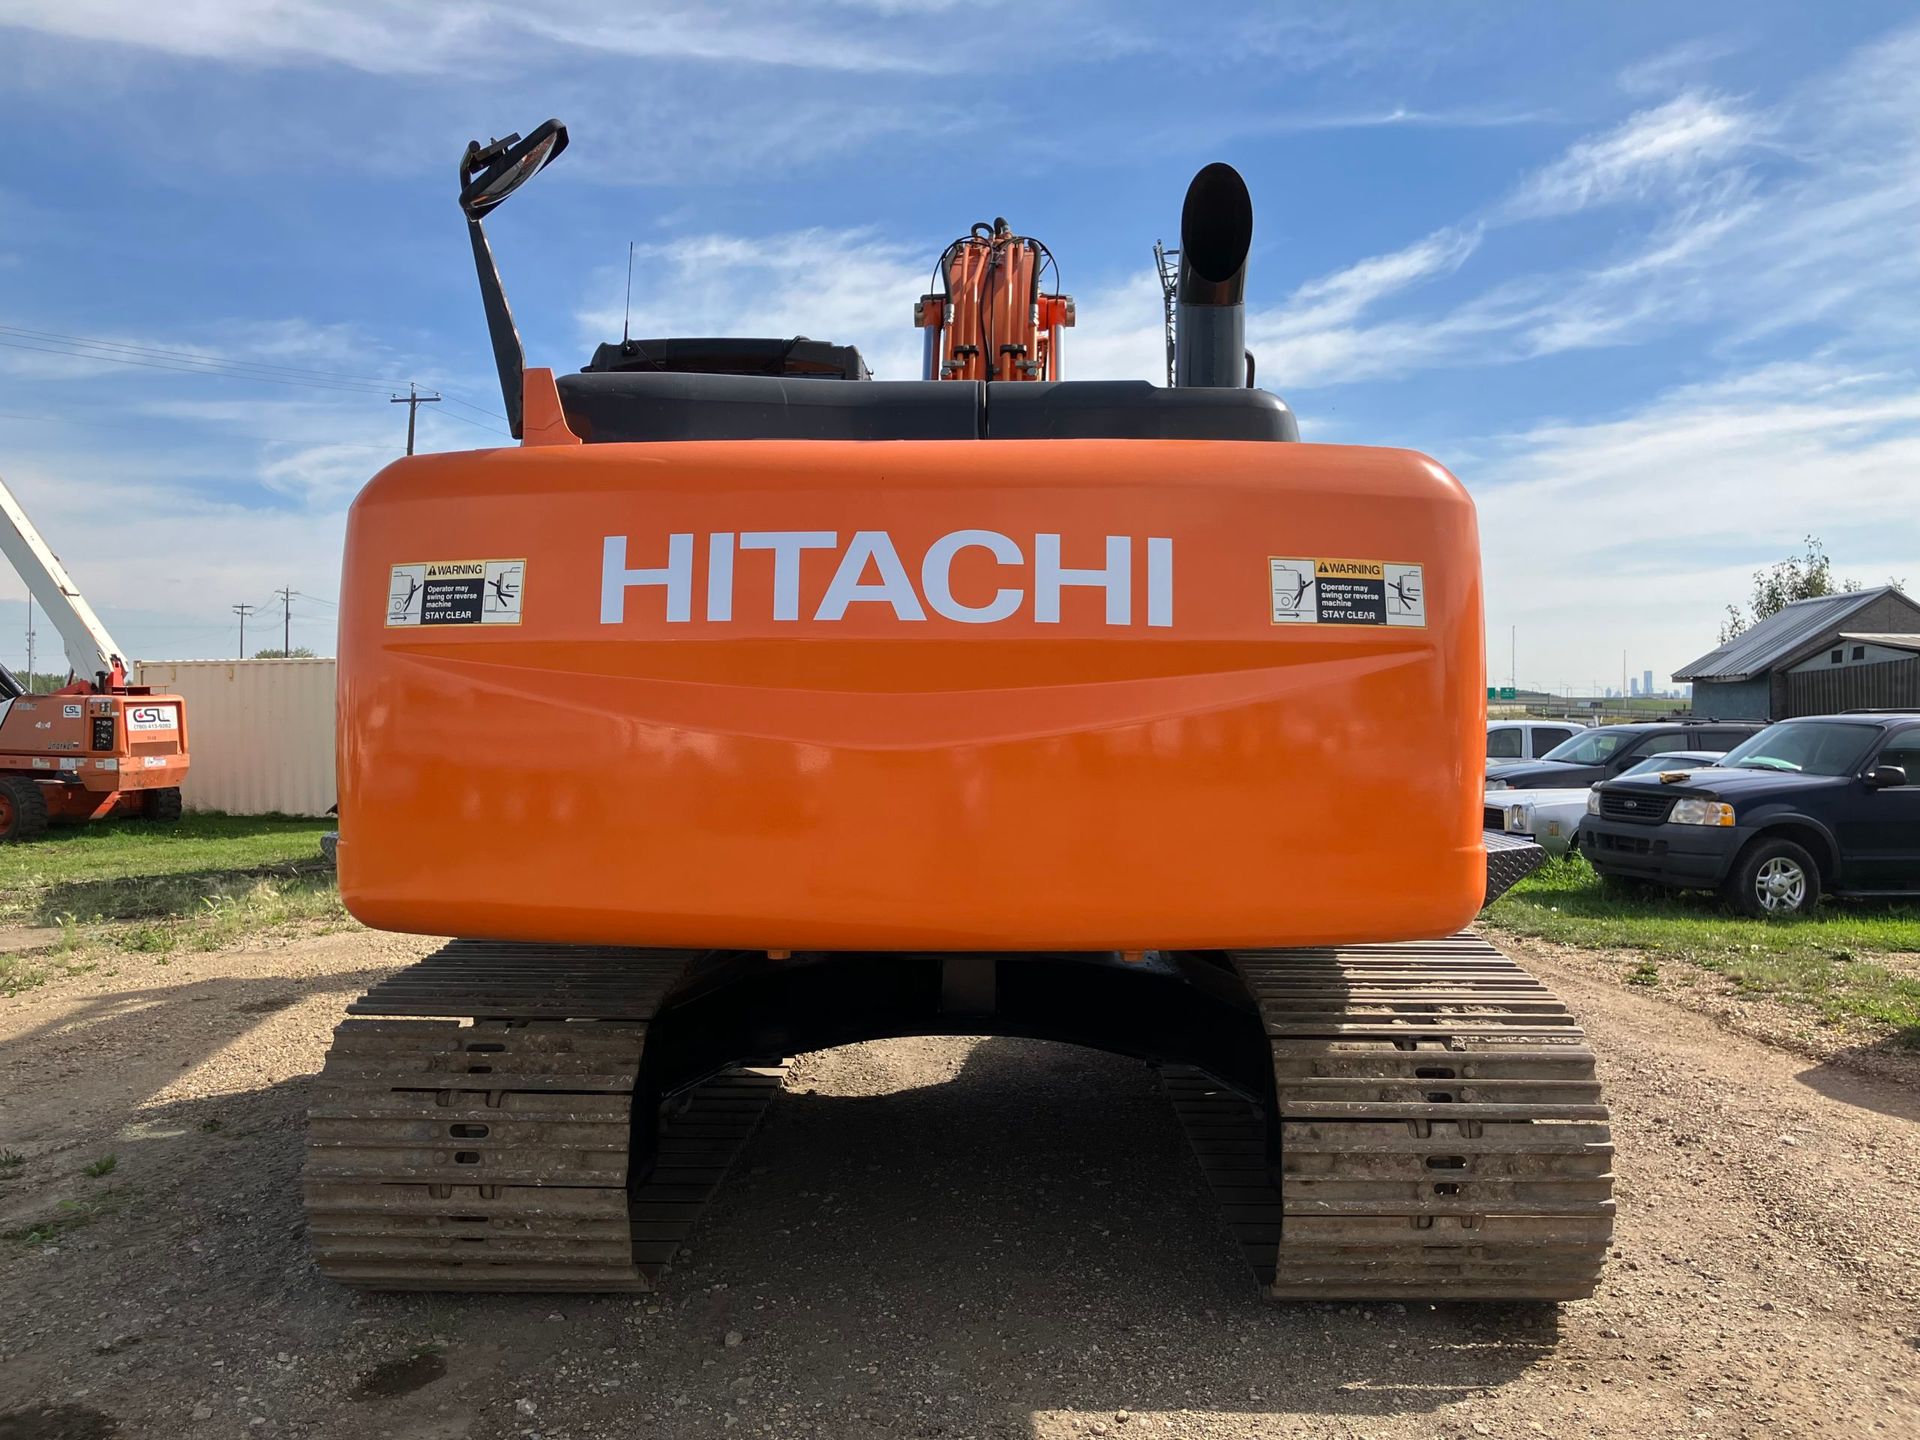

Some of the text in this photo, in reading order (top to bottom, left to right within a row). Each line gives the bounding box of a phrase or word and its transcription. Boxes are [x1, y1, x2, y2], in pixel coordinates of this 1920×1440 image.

[437, 564, 483, 575] WARNING
[1329, 563, 1381, 576] WARNING
[600, 529, 1173, 627] HITACHI
[427, 585, 469, 593] Operator may
[1320, 583, 1369, 593] Operator may
[426, 593, 445, 601] swing
[1321, 591, 1342, 600] swing
[424, 610, 472, 620] STAY CLEAR
[1322, 610, 1376, 620] STAY CLEAR
[65, 706, 80, 714] CSL
[133, 708, 171, 722] CSL
